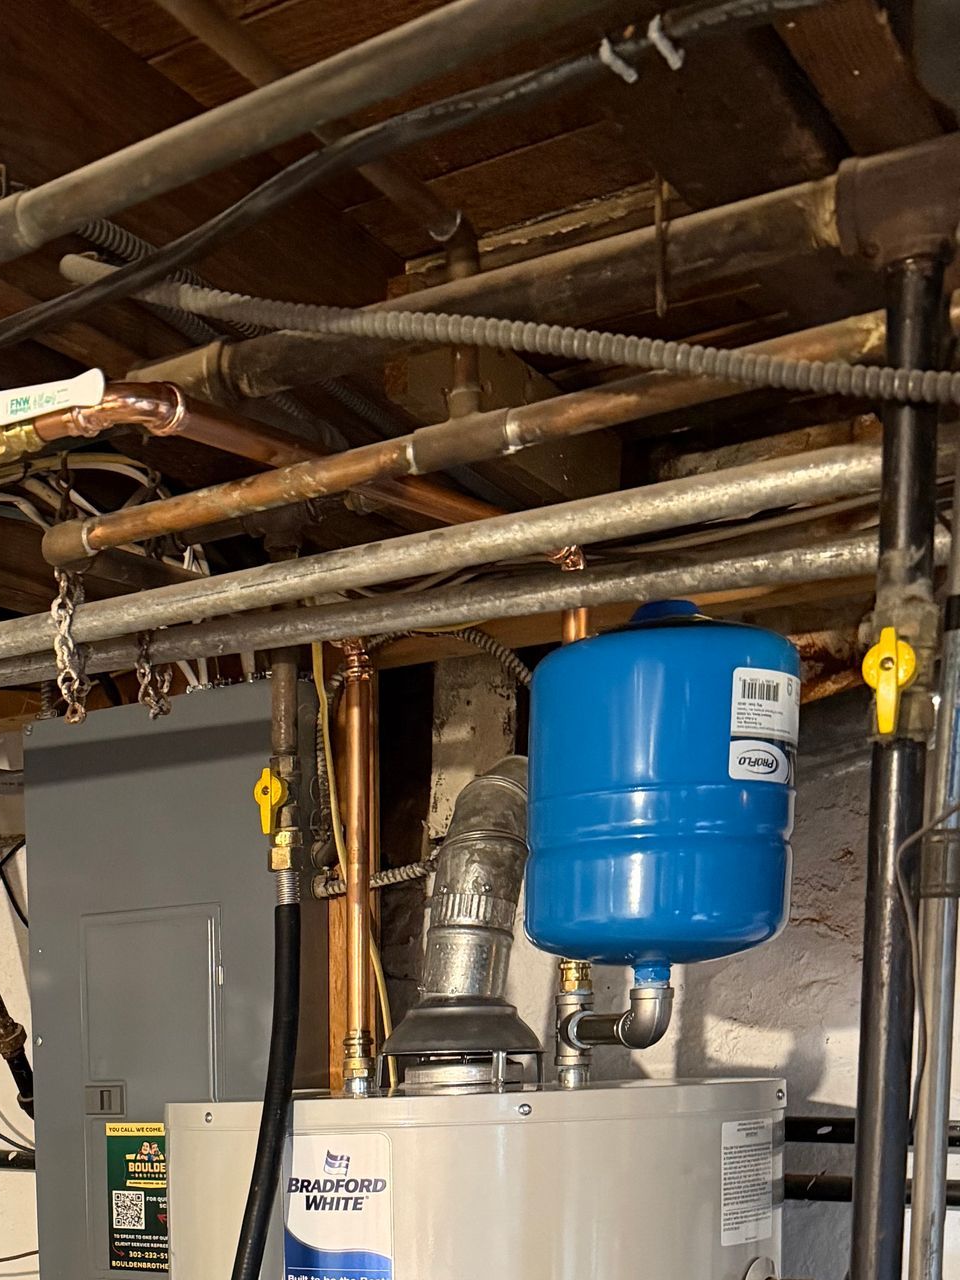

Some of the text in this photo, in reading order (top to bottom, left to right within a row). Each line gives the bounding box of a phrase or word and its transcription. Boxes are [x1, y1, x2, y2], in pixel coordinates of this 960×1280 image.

[10, 396, 30, 409] FNW
[738, 757, 774, 769] PROFLO
[129, 1162, 166, 1172] BOULDE
[287, 1178, 387, 1193] BRADFORD
[305, 1195, 364, 1210] WHITE
